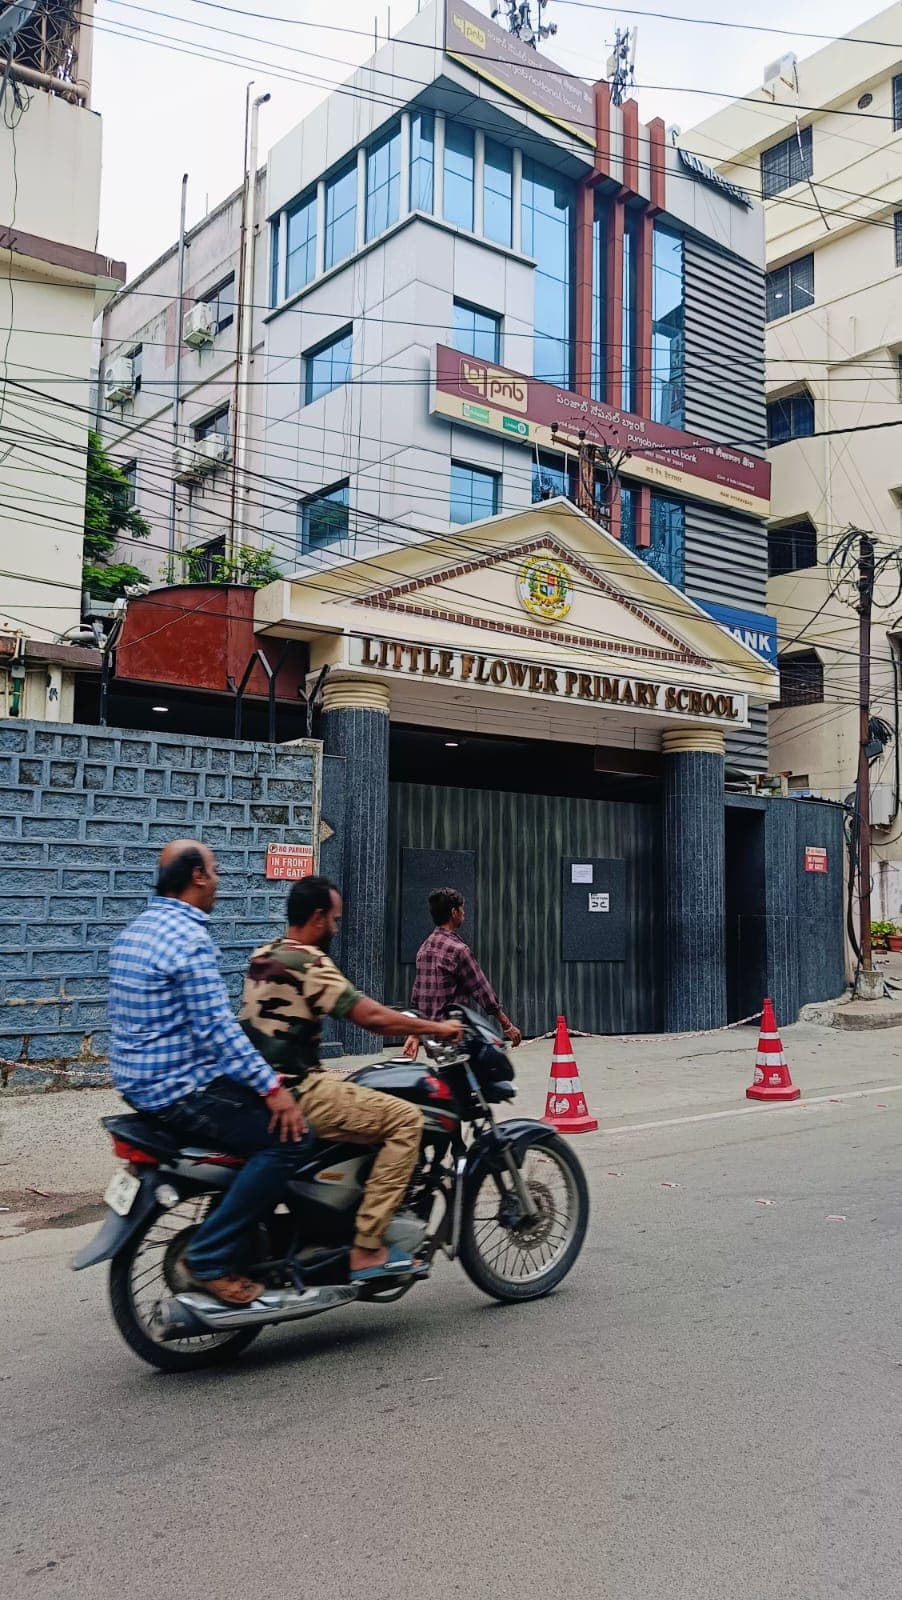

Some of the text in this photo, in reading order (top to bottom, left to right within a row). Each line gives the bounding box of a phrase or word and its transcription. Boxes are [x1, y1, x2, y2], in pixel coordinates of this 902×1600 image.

[466, 26, 484, 43] pnb
[490, 380, 524, 401] pnb
[627, 434, 652, 447] punjab
[680, 449, 697, 463] bank
[726, 625, 772, 653] ANK
[360, 637, 739, 719] LITTLE FLOWER PRIMARY SCHOOL
[288, 847, 312, 855] PARKING
[271, 857, 309, 868] IN FRONT
[273, 867, 306, 878] OF GATE
